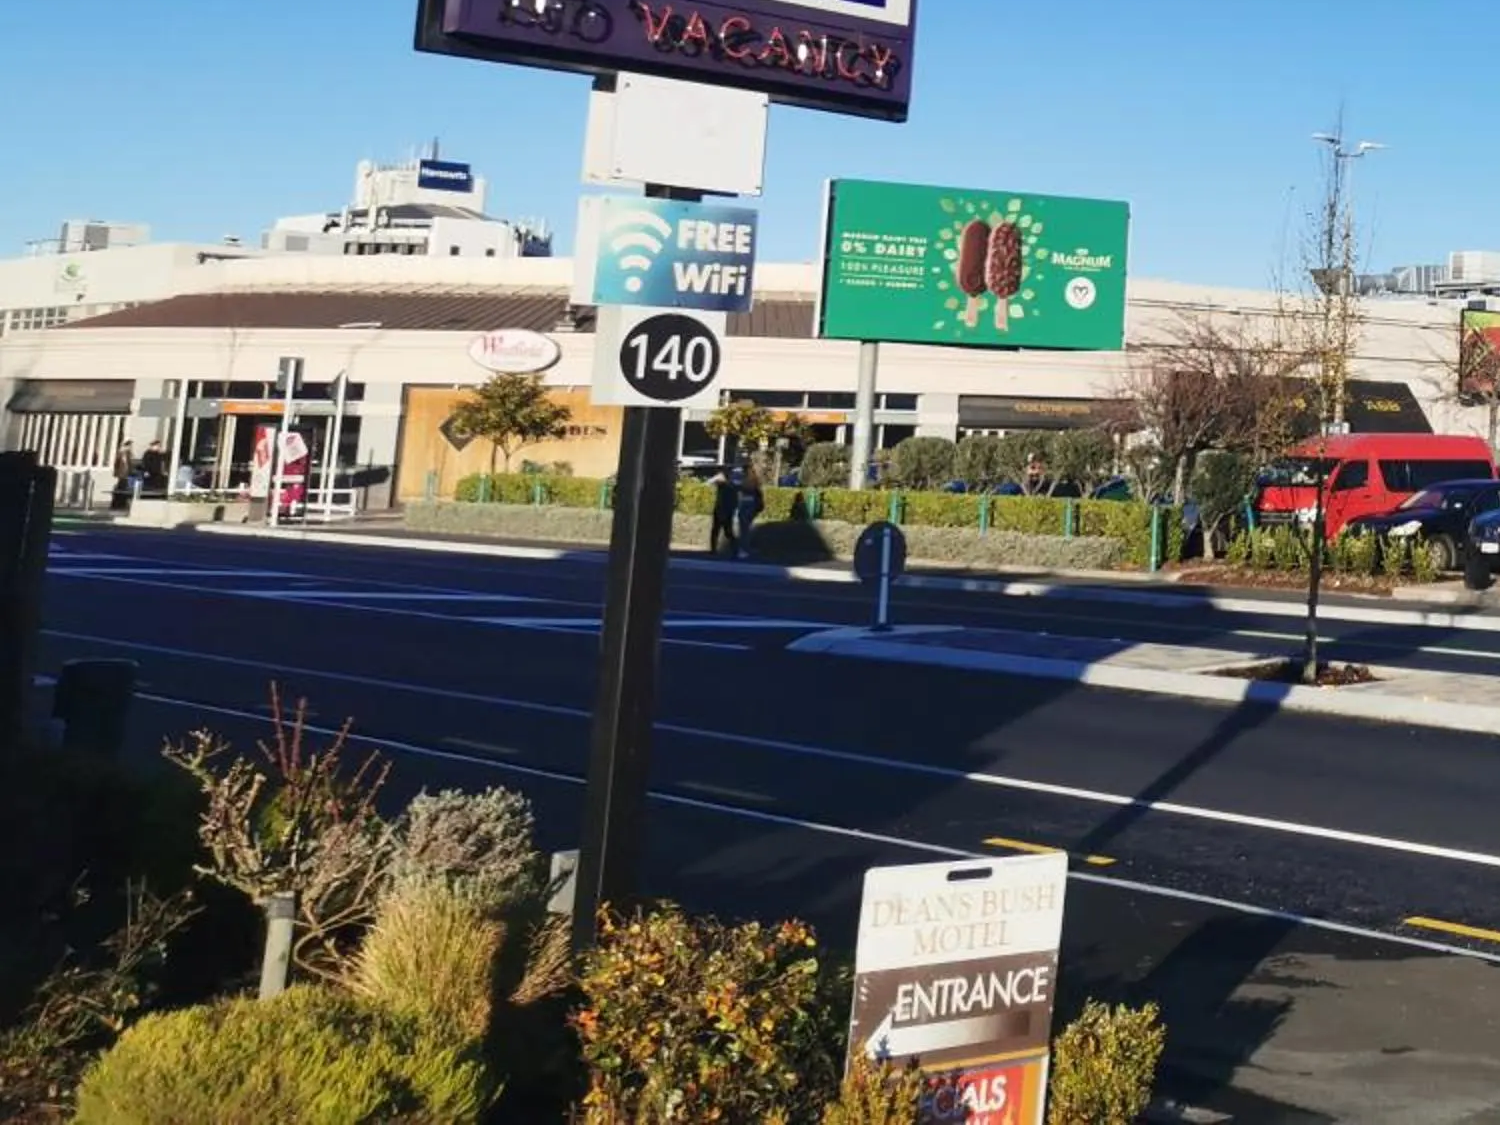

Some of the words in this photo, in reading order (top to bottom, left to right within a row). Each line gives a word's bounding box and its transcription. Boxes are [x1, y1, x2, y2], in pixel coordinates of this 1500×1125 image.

[638, 0, 897, 87] VACANCY
[676, 219, 752, 254] FREE
[841, 241, 867, 253] 0%
[875, 243, 927, 257] DAIRY
[674, 262, 748, 298] WiFi
[628, 332, 715, 384] 140
[872, 890, 973, 928] DEANS
[981, 883, 1056, 917] BUSH
[912, 920, 1013, 956] MOTEL
[895, 966, 1050, 1022] ENTRANCE
